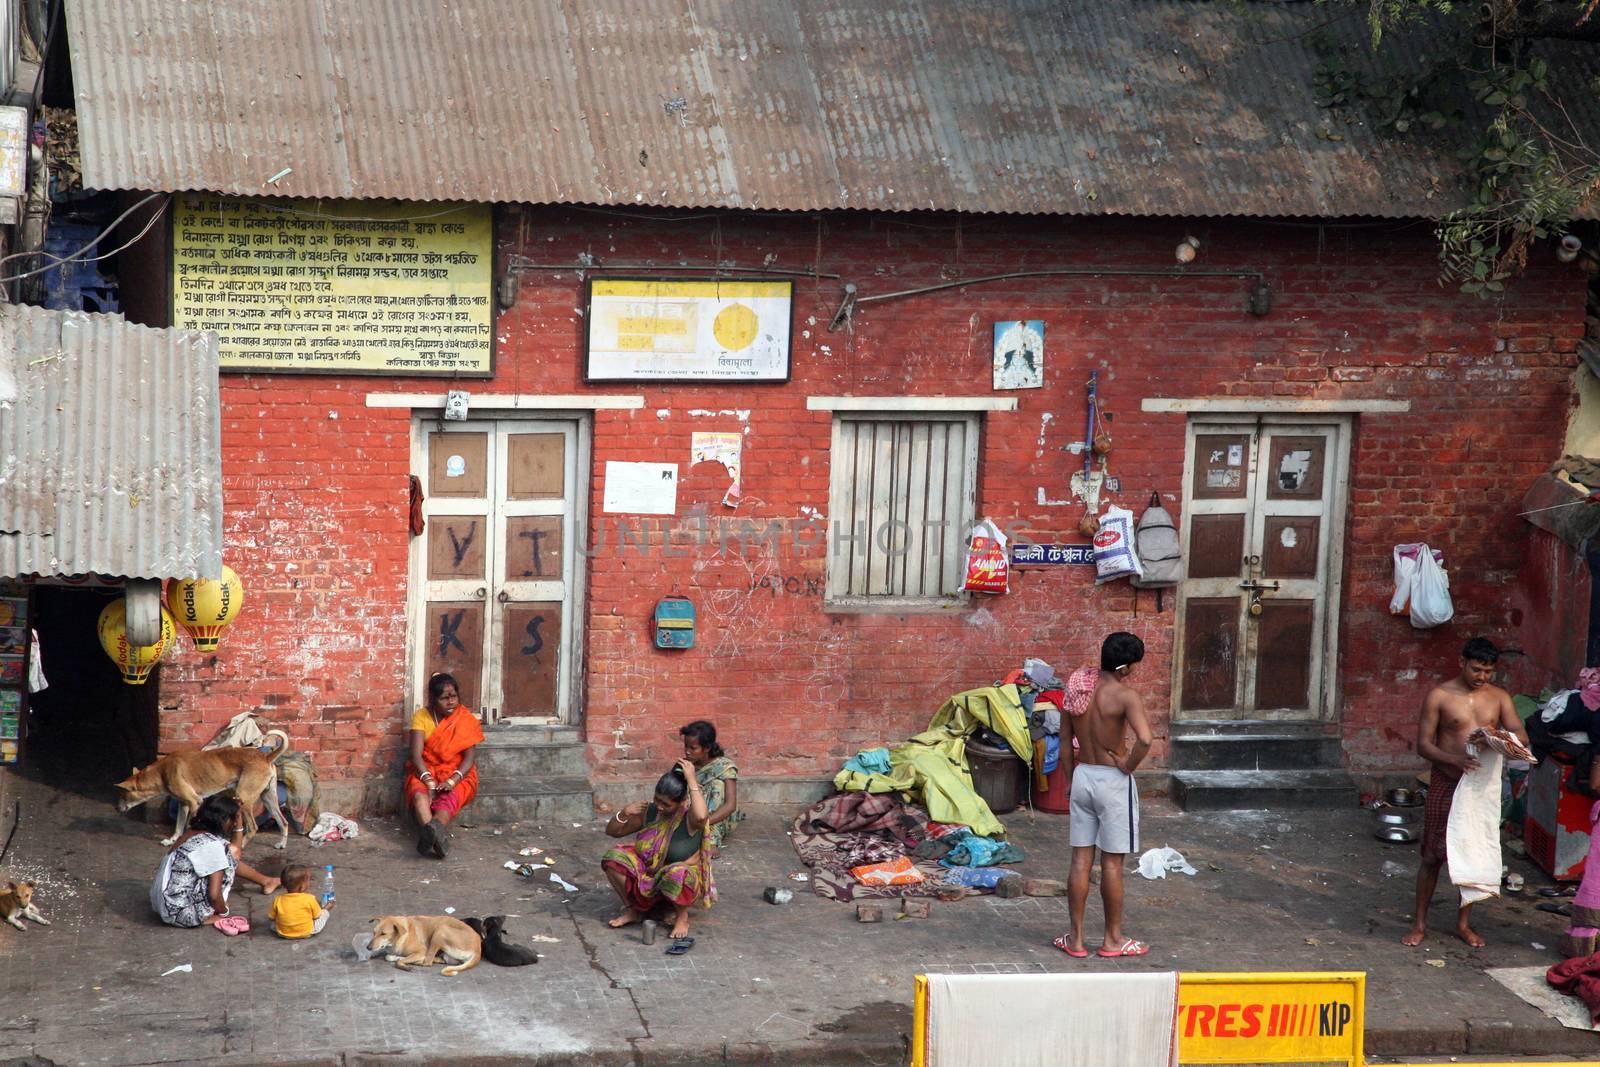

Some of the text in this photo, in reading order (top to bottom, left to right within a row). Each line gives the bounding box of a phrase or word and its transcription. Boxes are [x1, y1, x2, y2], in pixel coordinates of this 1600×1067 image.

[181, 215, 196, 227] এই
[229, 218, 240, 228] বা
[253, 234, 272, 246] রোগ
[308, 235, 328, 246] এবং
[333, 233, 371, 247] চিকিৎসা
[378, 236, 396, 248] করা
[221, 245, 250, 260] অধিক
[286, 266, 305, 277] রোগ
[337, 264, 369, 279] নিরাময়
[402, 268, 418, 278] তবে
[420, 268, 448, 280] সপ্তাহে
[218, 280, 247, 291] এখানে
[247, 281, 264, 291] এসে
[289, 281, 311, 292] খেতে
[205, 290, 226, 303] রোগী
[205, 308, 224, 318] রোগ
[269, 306, 292, 319] কাশি
[293, 311, 301, 320] ও
[336, 310, 368, 321] মাধ্যমে
[370, 309, 384, 320] এই
[387, 311, 415, 322] রোগের
[418, 311, 452, 321] সংক্রমণ
[321, 323, 332, 333] না
[353, 322, 379, 335] কাশির
[381, 325, 402, 335] সময়
[443, 325, 452, 334] বা
[274, 351, 294, 361] জেলা
[1015, 544, 1045, 561] কালী
[183, 582, 197, 622] Kodak
[216, 582, 229, 622] Kodak
[1178, 1004, 1264, 1038] RES
